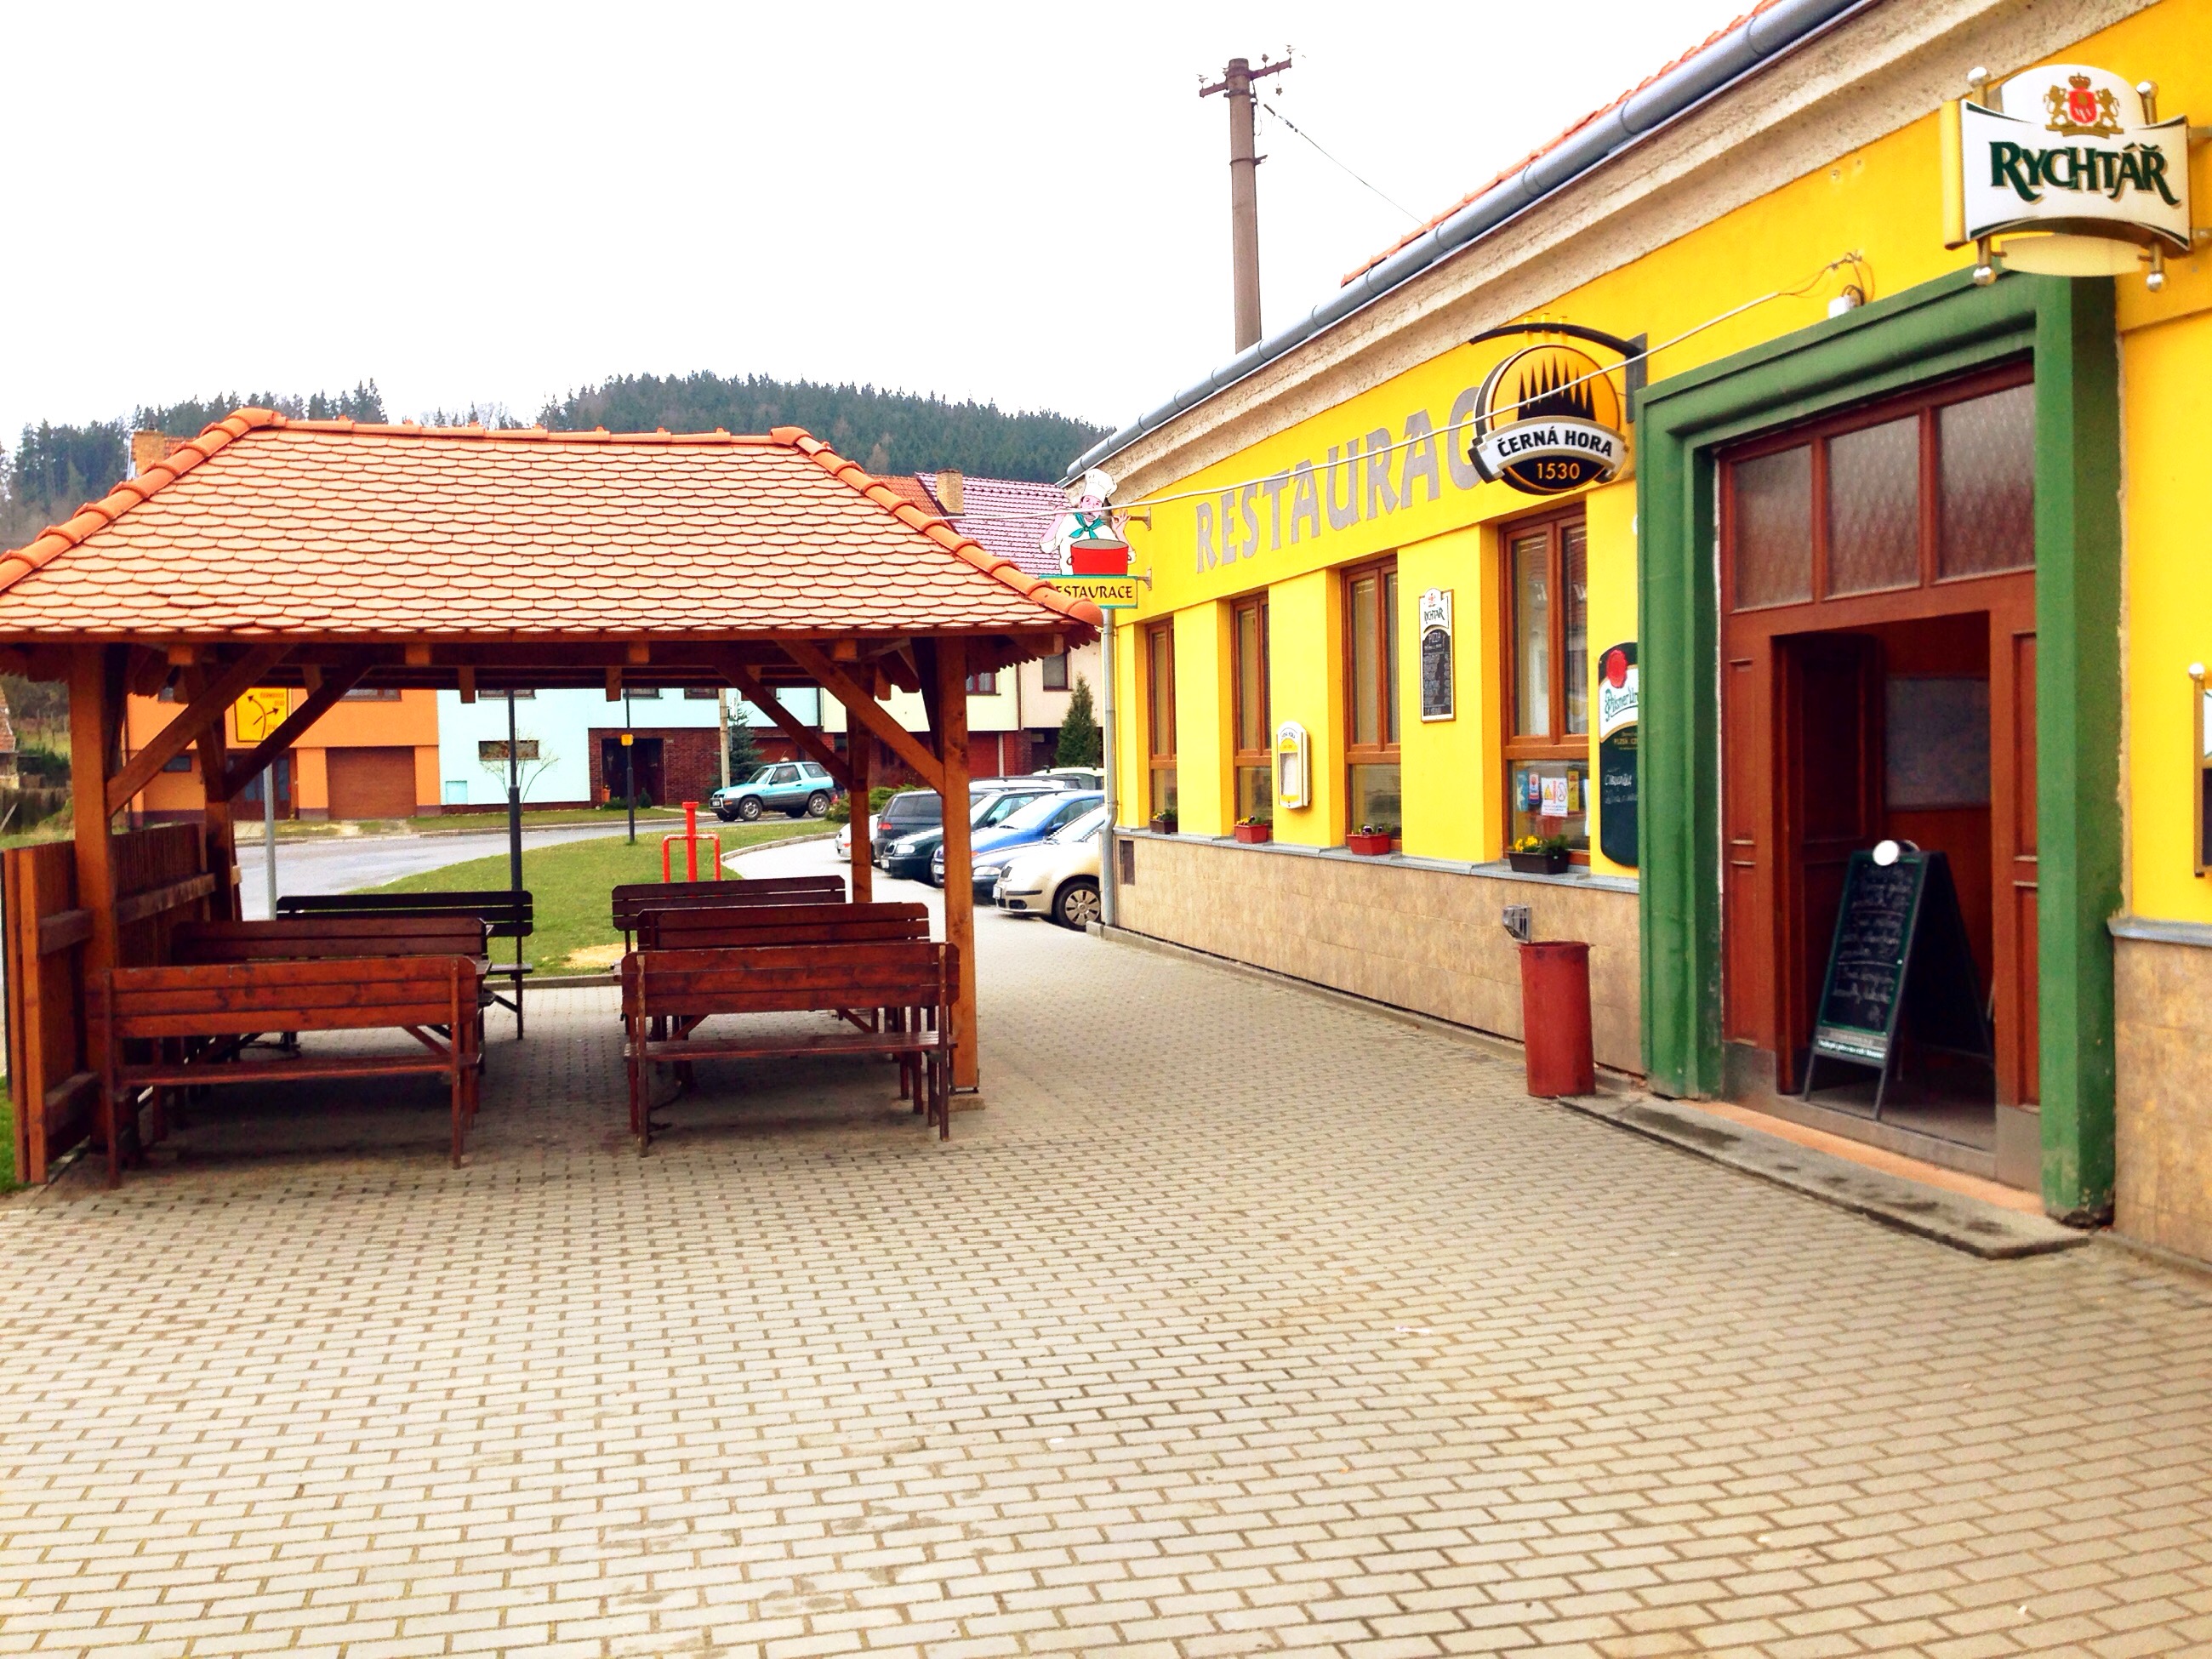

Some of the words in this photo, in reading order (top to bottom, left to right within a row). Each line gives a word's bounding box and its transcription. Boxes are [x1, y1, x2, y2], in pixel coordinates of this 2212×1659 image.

[1988, 141, 2182, 208] RYCHTÁŘ
[1497, 425, 1559, 458] ČERNÁ
[1565, 430, 1614, 457] HORA
[1195, 386, 1482, 573] RESTAURAC
[1536, 462, 1581, 480] 1530
